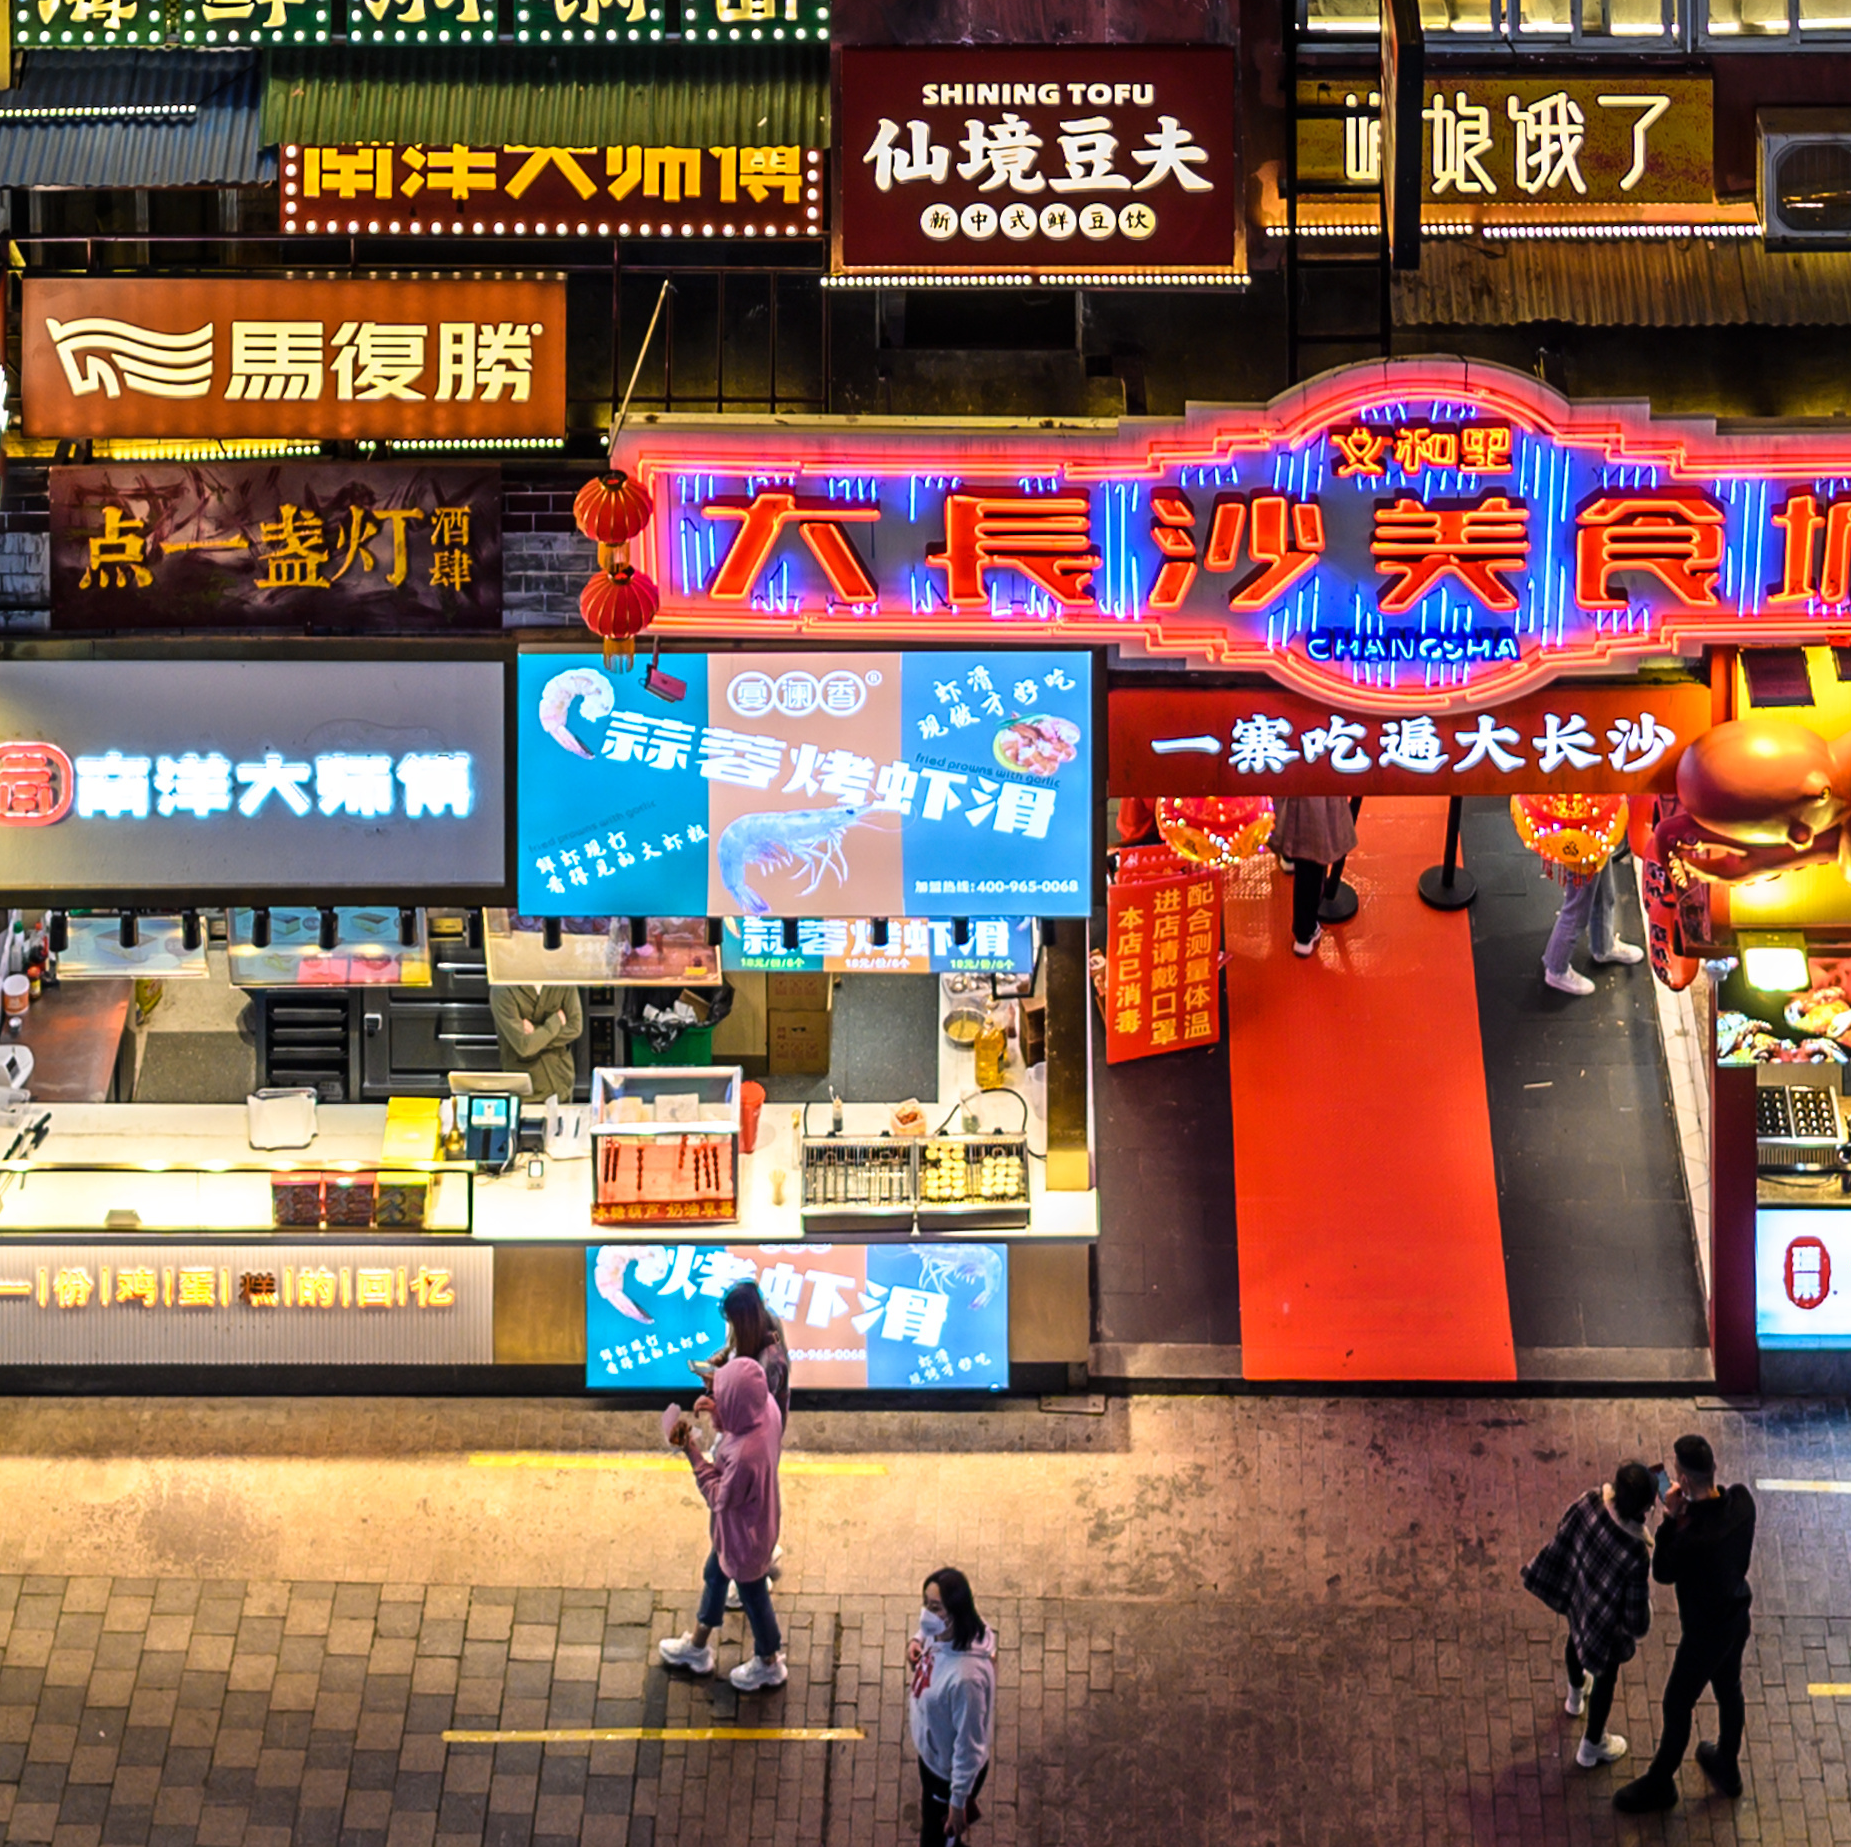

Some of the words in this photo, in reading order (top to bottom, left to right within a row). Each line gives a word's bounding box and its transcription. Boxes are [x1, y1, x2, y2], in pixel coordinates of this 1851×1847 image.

[922, 83, 1060, 105] SHINING
[1068, 83, 1155, 105] TOFU
[862, 114, 1214, 195] 仙境豆夫
[925, 206, 1153, 236] 新中式鲜豆饮
[224, 320, 534, 402] 馬復勝
[1330, 428, 1512, 476] 文和里
[79, 503, 424, 590] 点一盏灯
[429, 506, 473, 591] 酒肆
[1307, 636, 1519, 661] CHANGSHA
[600, 710, 1058, 840] 蒜蓉烤虾滑
[1151, 712, 1676, 776] 一寨吃遍大长沙
[1116, 905, 1144, 1034] 本店已消毒
[1150, 888, 1182, 1046] 进店请戴口罩
[1183, 880, 1215, 1039] 配合测量体温
